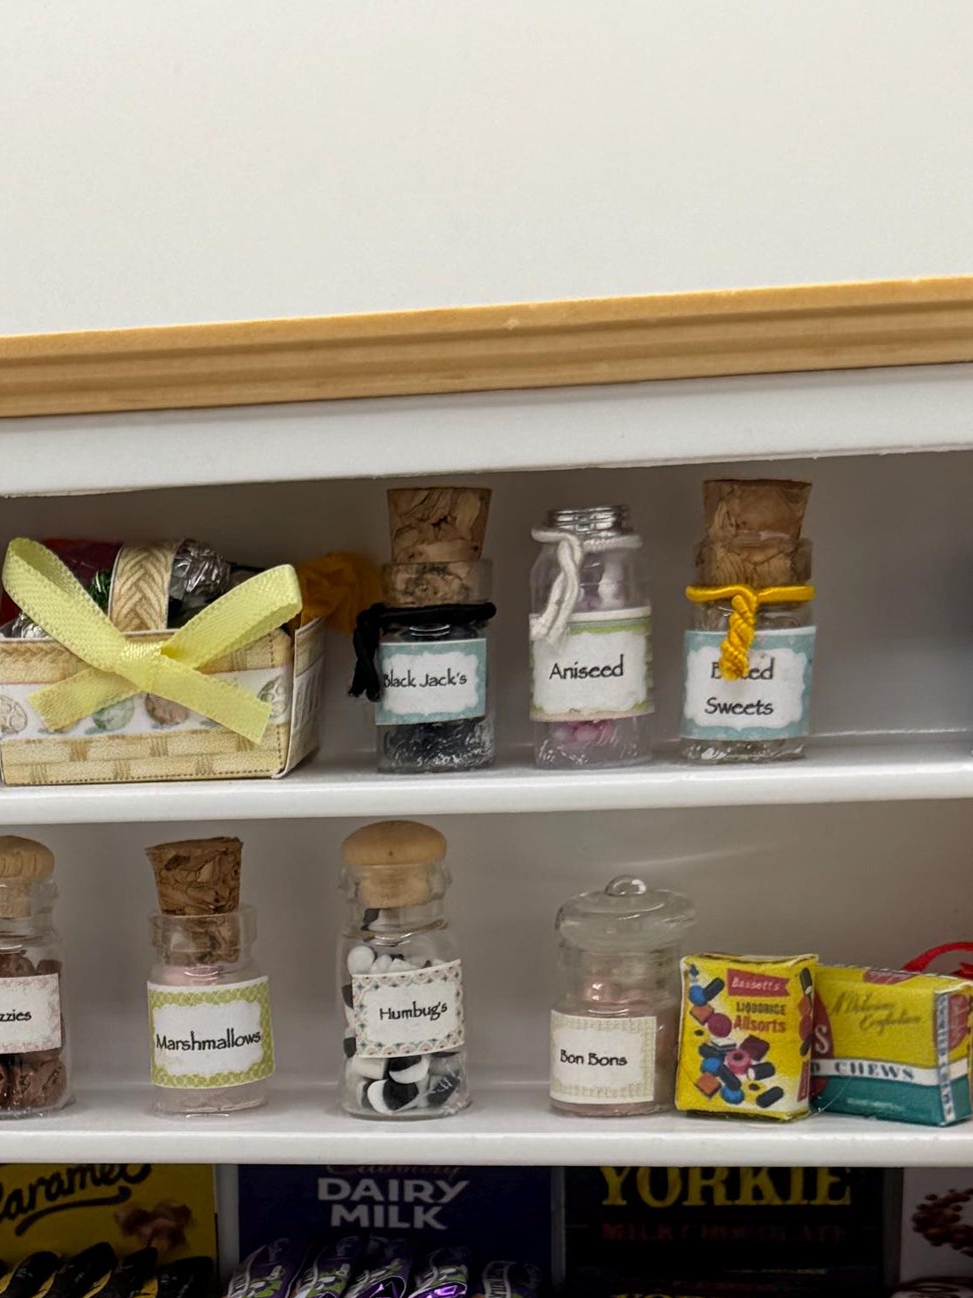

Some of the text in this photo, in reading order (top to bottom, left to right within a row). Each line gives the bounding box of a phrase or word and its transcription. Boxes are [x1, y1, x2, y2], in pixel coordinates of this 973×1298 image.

[419, 667, 467, 688] Jack's
[549, 661, 624, 680] Aniseed
[704, 697, 774, 716] Sweets
[379, 1001, 448, 1022] Humbug's
[734, 1015, 786, 1033] Allsorts
[156, 1030, 262, 1051] Marshmallows
[560, 1050, 628, 1066] Bon Bons
[834, 1061, 914, 1081] CHEWS
[316, 1176, 471, 1204] DAIRY
[599, 1166, 852, 1208] YORKIE
[330, 1204, 448, 1230] MILK
